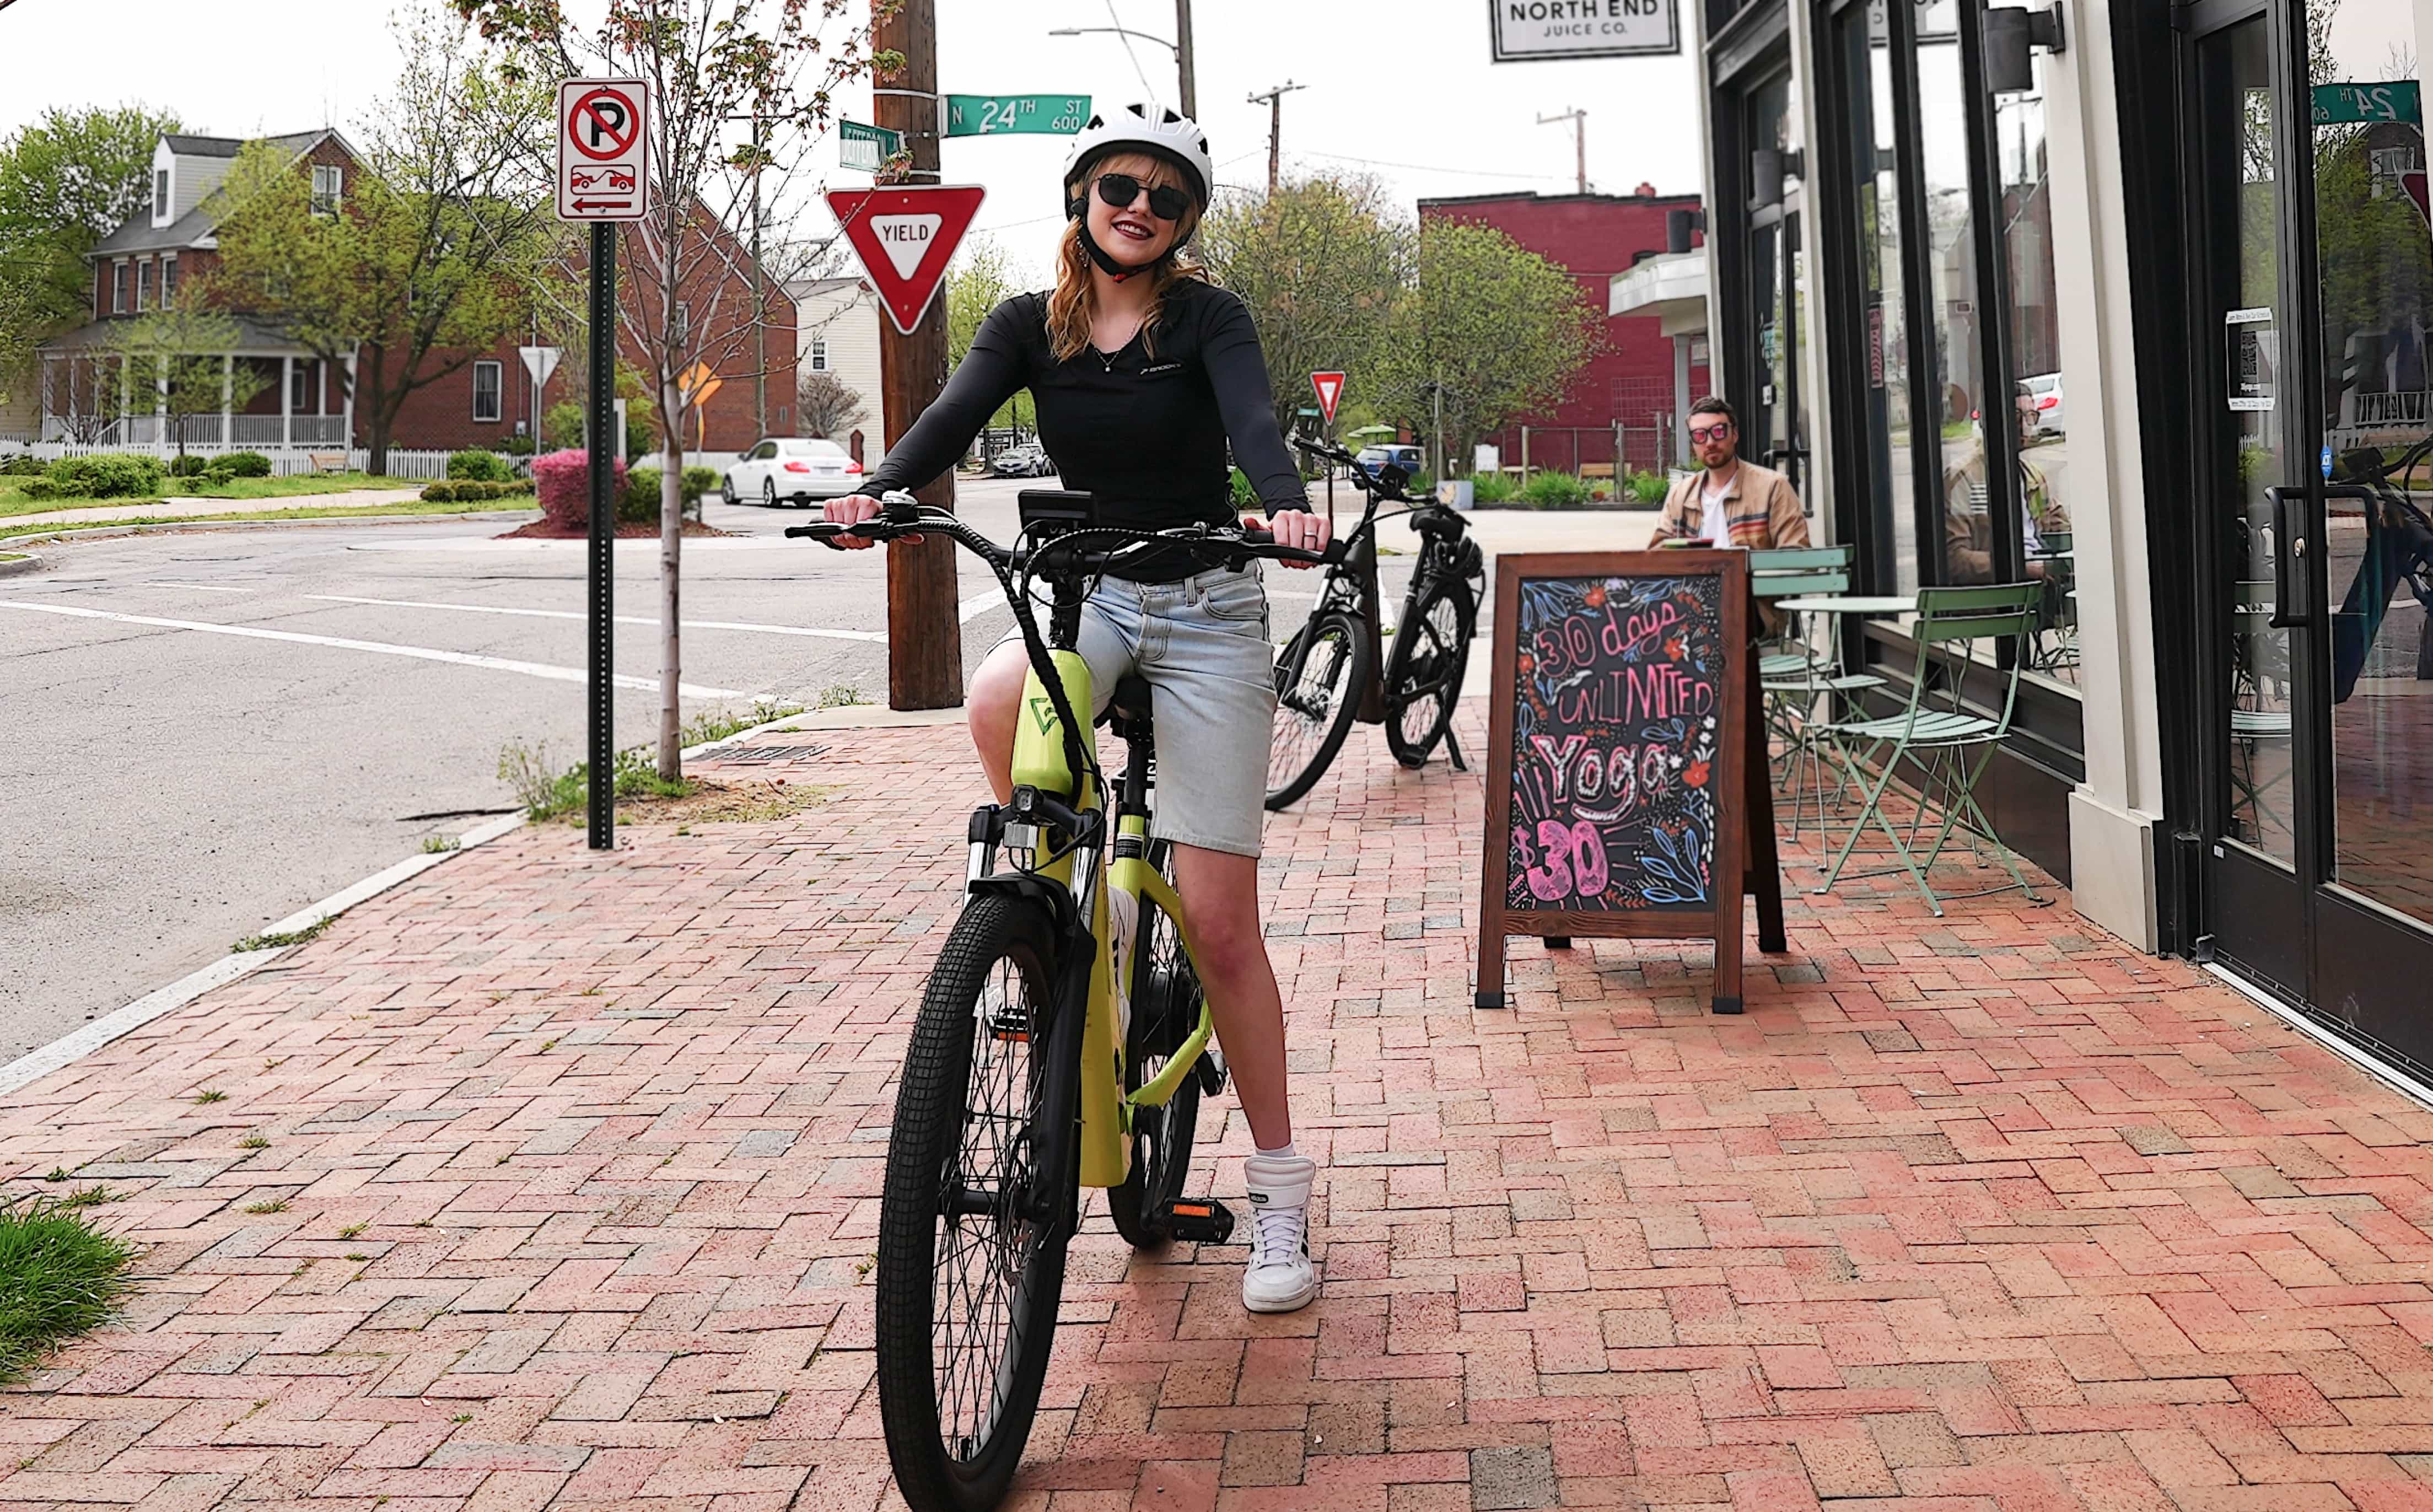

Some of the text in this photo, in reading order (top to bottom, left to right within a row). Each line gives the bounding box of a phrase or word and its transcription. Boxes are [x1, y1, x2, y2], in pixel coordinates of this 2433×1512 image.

[1510, 0, 1657, 21] NORTH END
[1544, 22, 1628, 37] JUICE CO.
[952, 99, 1083, 133] N 24TH ST
[1051, 116, 1080, 130] 600
[882, 224, 928, 241] YIELD
[1537, 602, 1688, 678] 30 days
[1529, 735, 1668, 825] Yoga
[1511, 819, 1609, 902] $30
